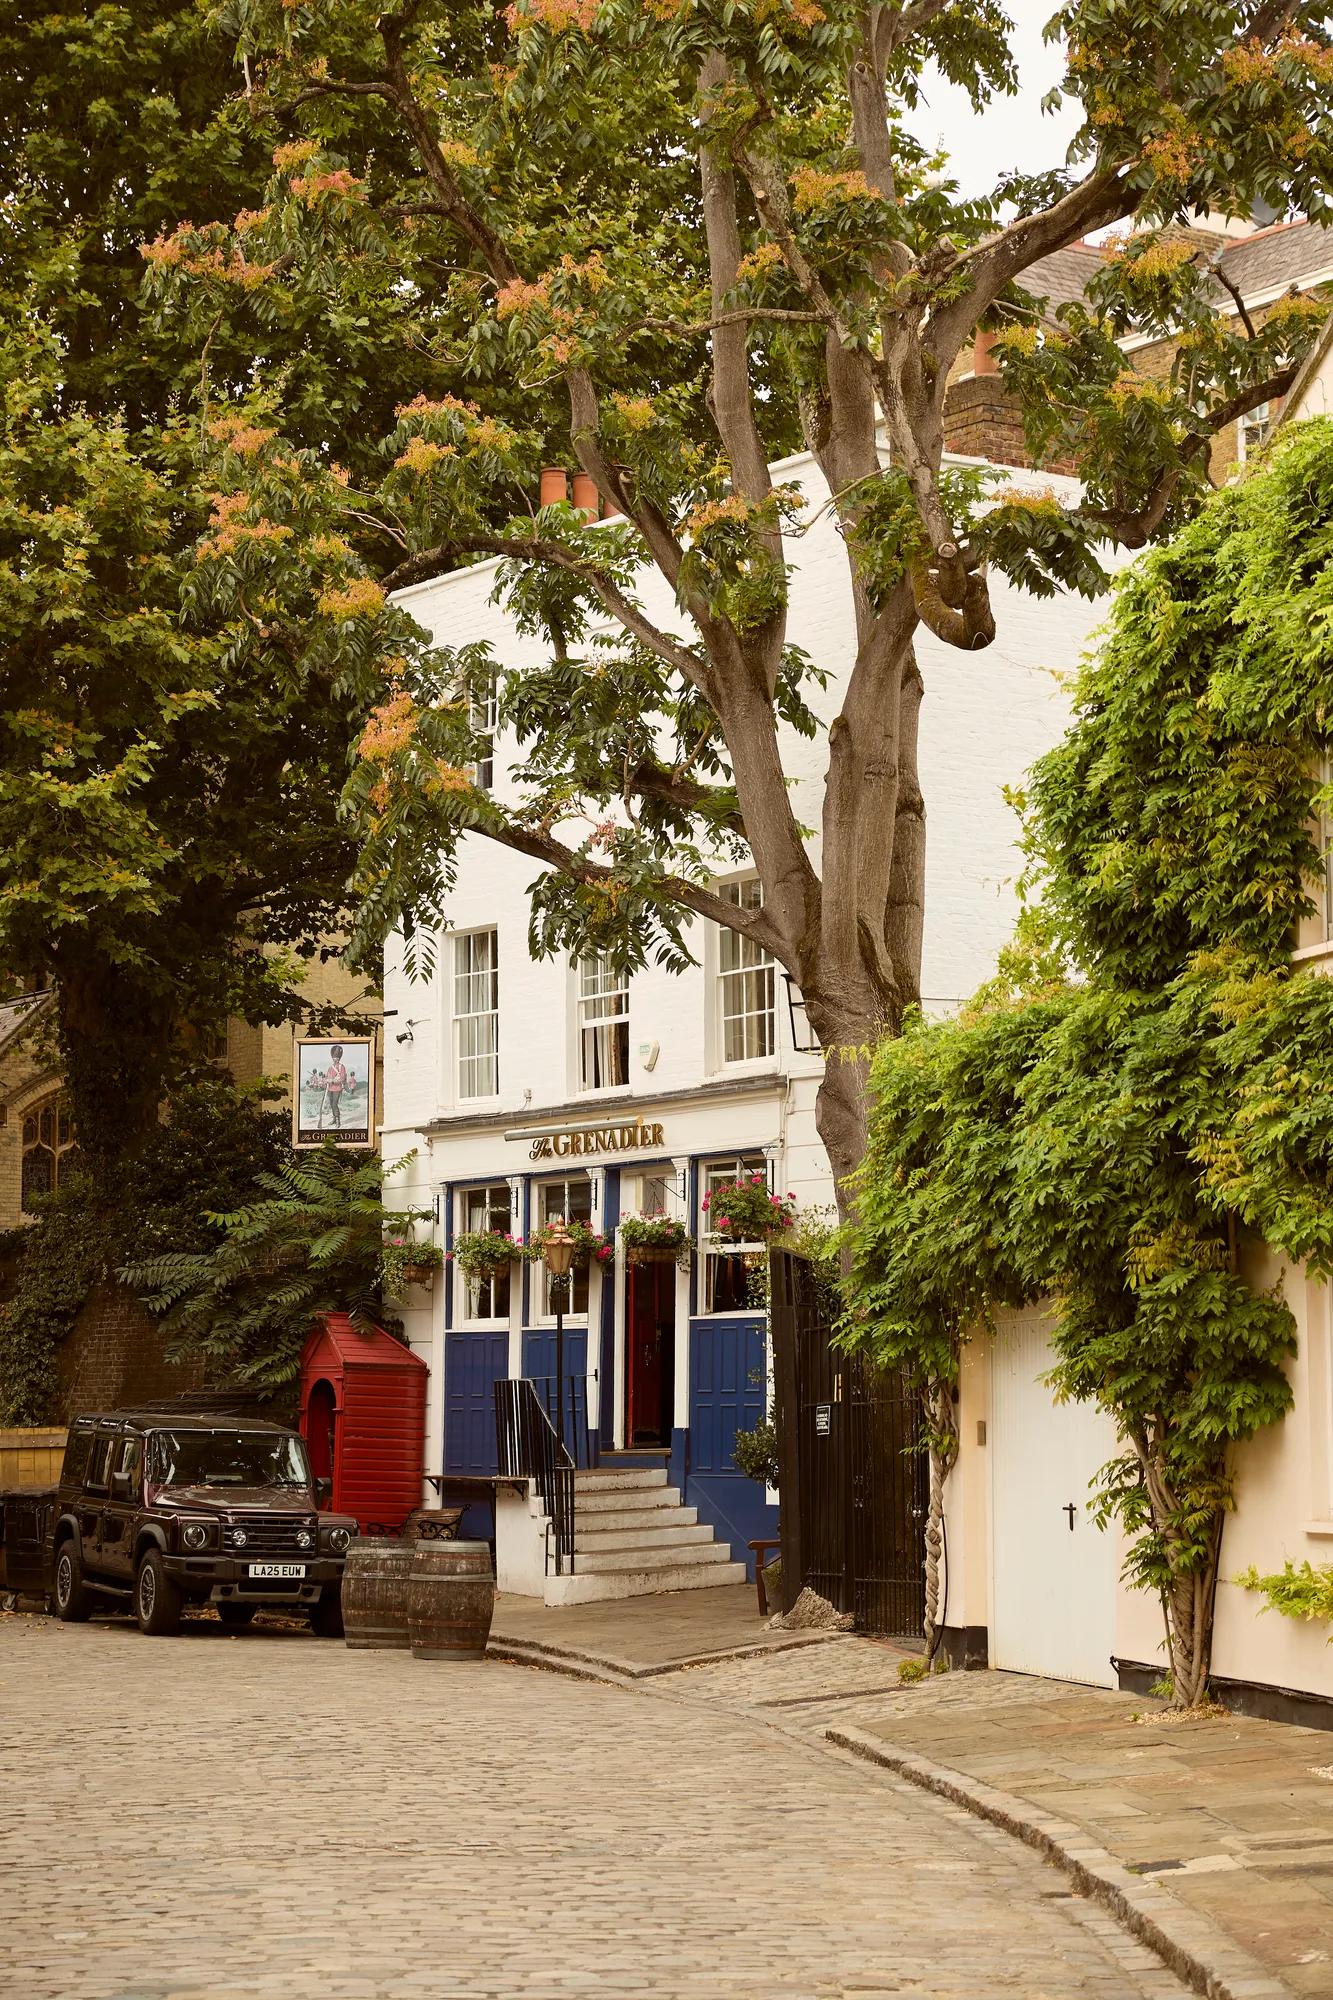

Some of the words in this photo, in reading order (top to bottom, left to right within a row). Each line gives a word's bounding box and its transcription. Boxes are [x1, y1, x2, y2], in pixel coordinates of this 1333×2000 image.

[312, 1132, 366, 1141] GRADIER
[529, 1137, 553, 1160] The
[552, 1123, 664, 1156] GRENADIER
[253, 1566, 280, 1576] LA25
[282, 1566, 302, 1576] EUW
